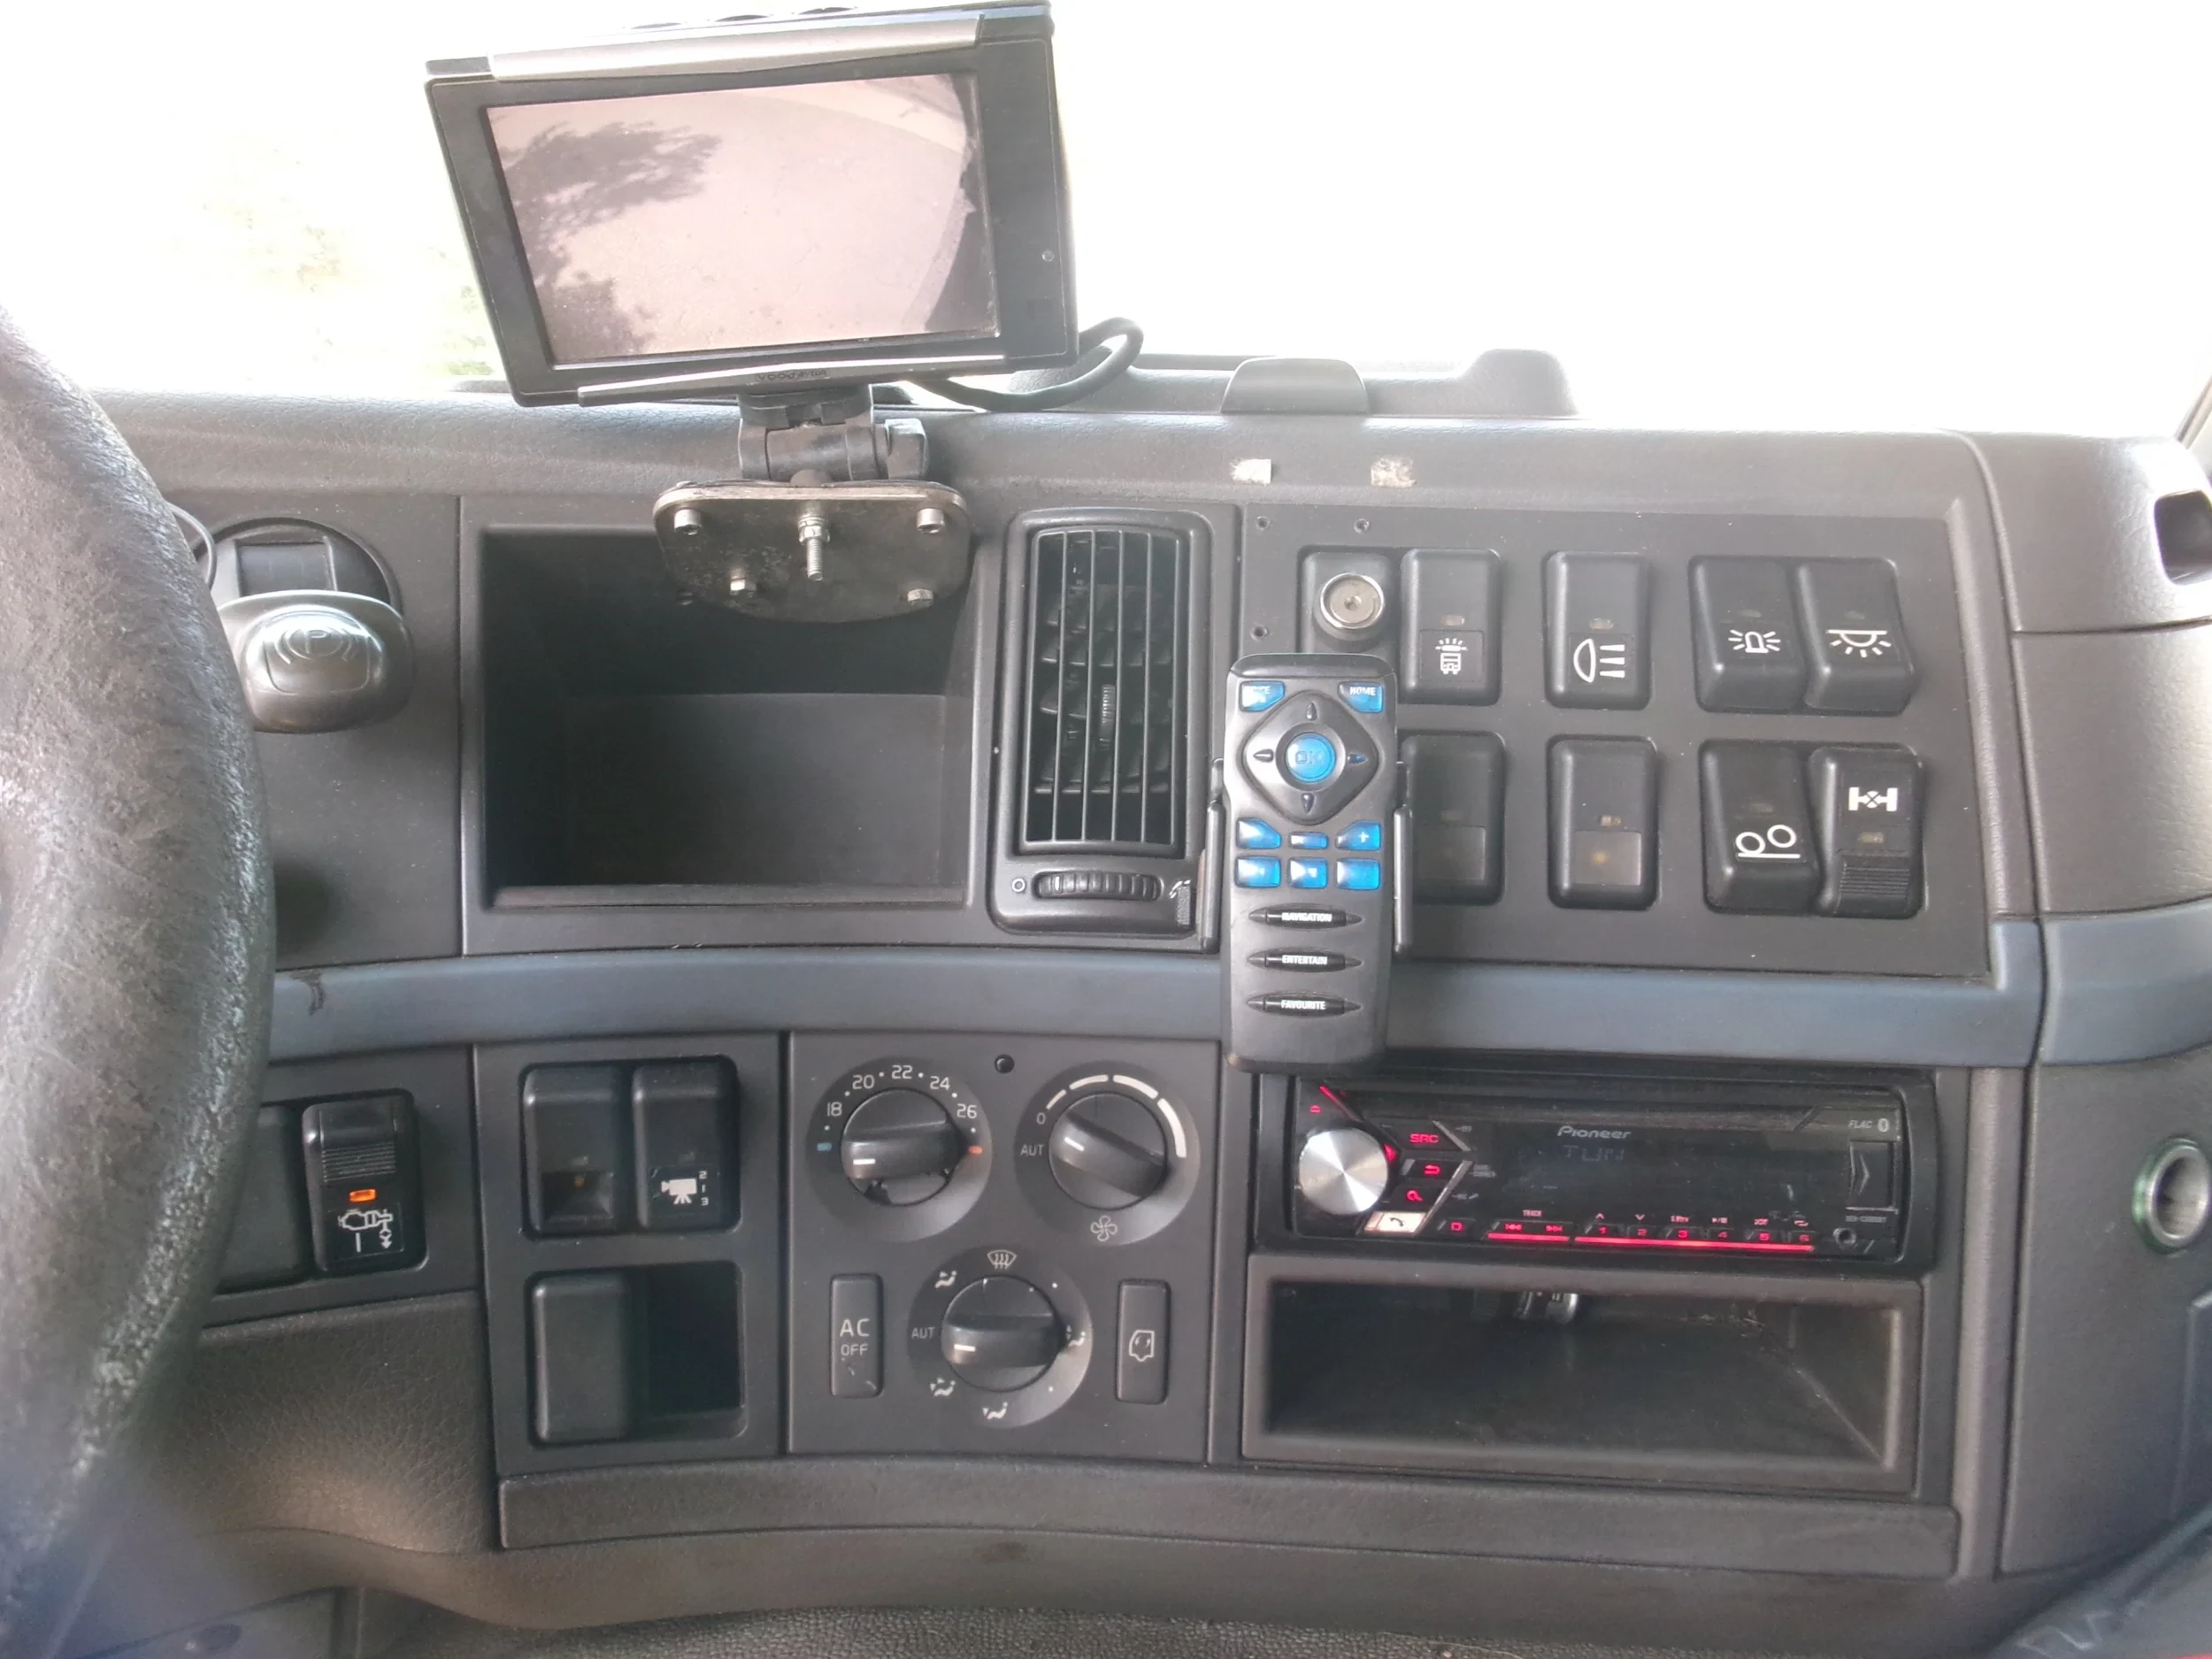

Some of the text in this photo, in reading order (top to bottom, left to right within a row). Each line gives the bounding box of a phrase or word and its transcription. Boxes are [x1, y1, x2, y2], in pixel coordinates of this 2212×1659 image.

[1349, 687, 1377, 696] HOME
[1294, 750, 1325, 765] OK
[1281, 912, 1333, 923] NAVIGATION
[1281, 955, 1328, 965] ENTERTAIN
[1280, 999, 1326, 1010] FAVOURITE
[826, 1065, 978, 1118] 18 20 22 24 26
[1409, 1133, 1440, 1143] SRC
[1557, 1125, 1632, 1140] Pioneer
[1020, 1144, 1045, 1156] AUT
[698, 1171, 707, 1179] 2
[700, 1196, 710, 1206] 3
[1678, 1230, 1687, 1239] 3
[840, 1318, 870, 1337] AC
[910, 1327, 934, 1340] AUT
[841, 1343, 868, 1356] OFF
